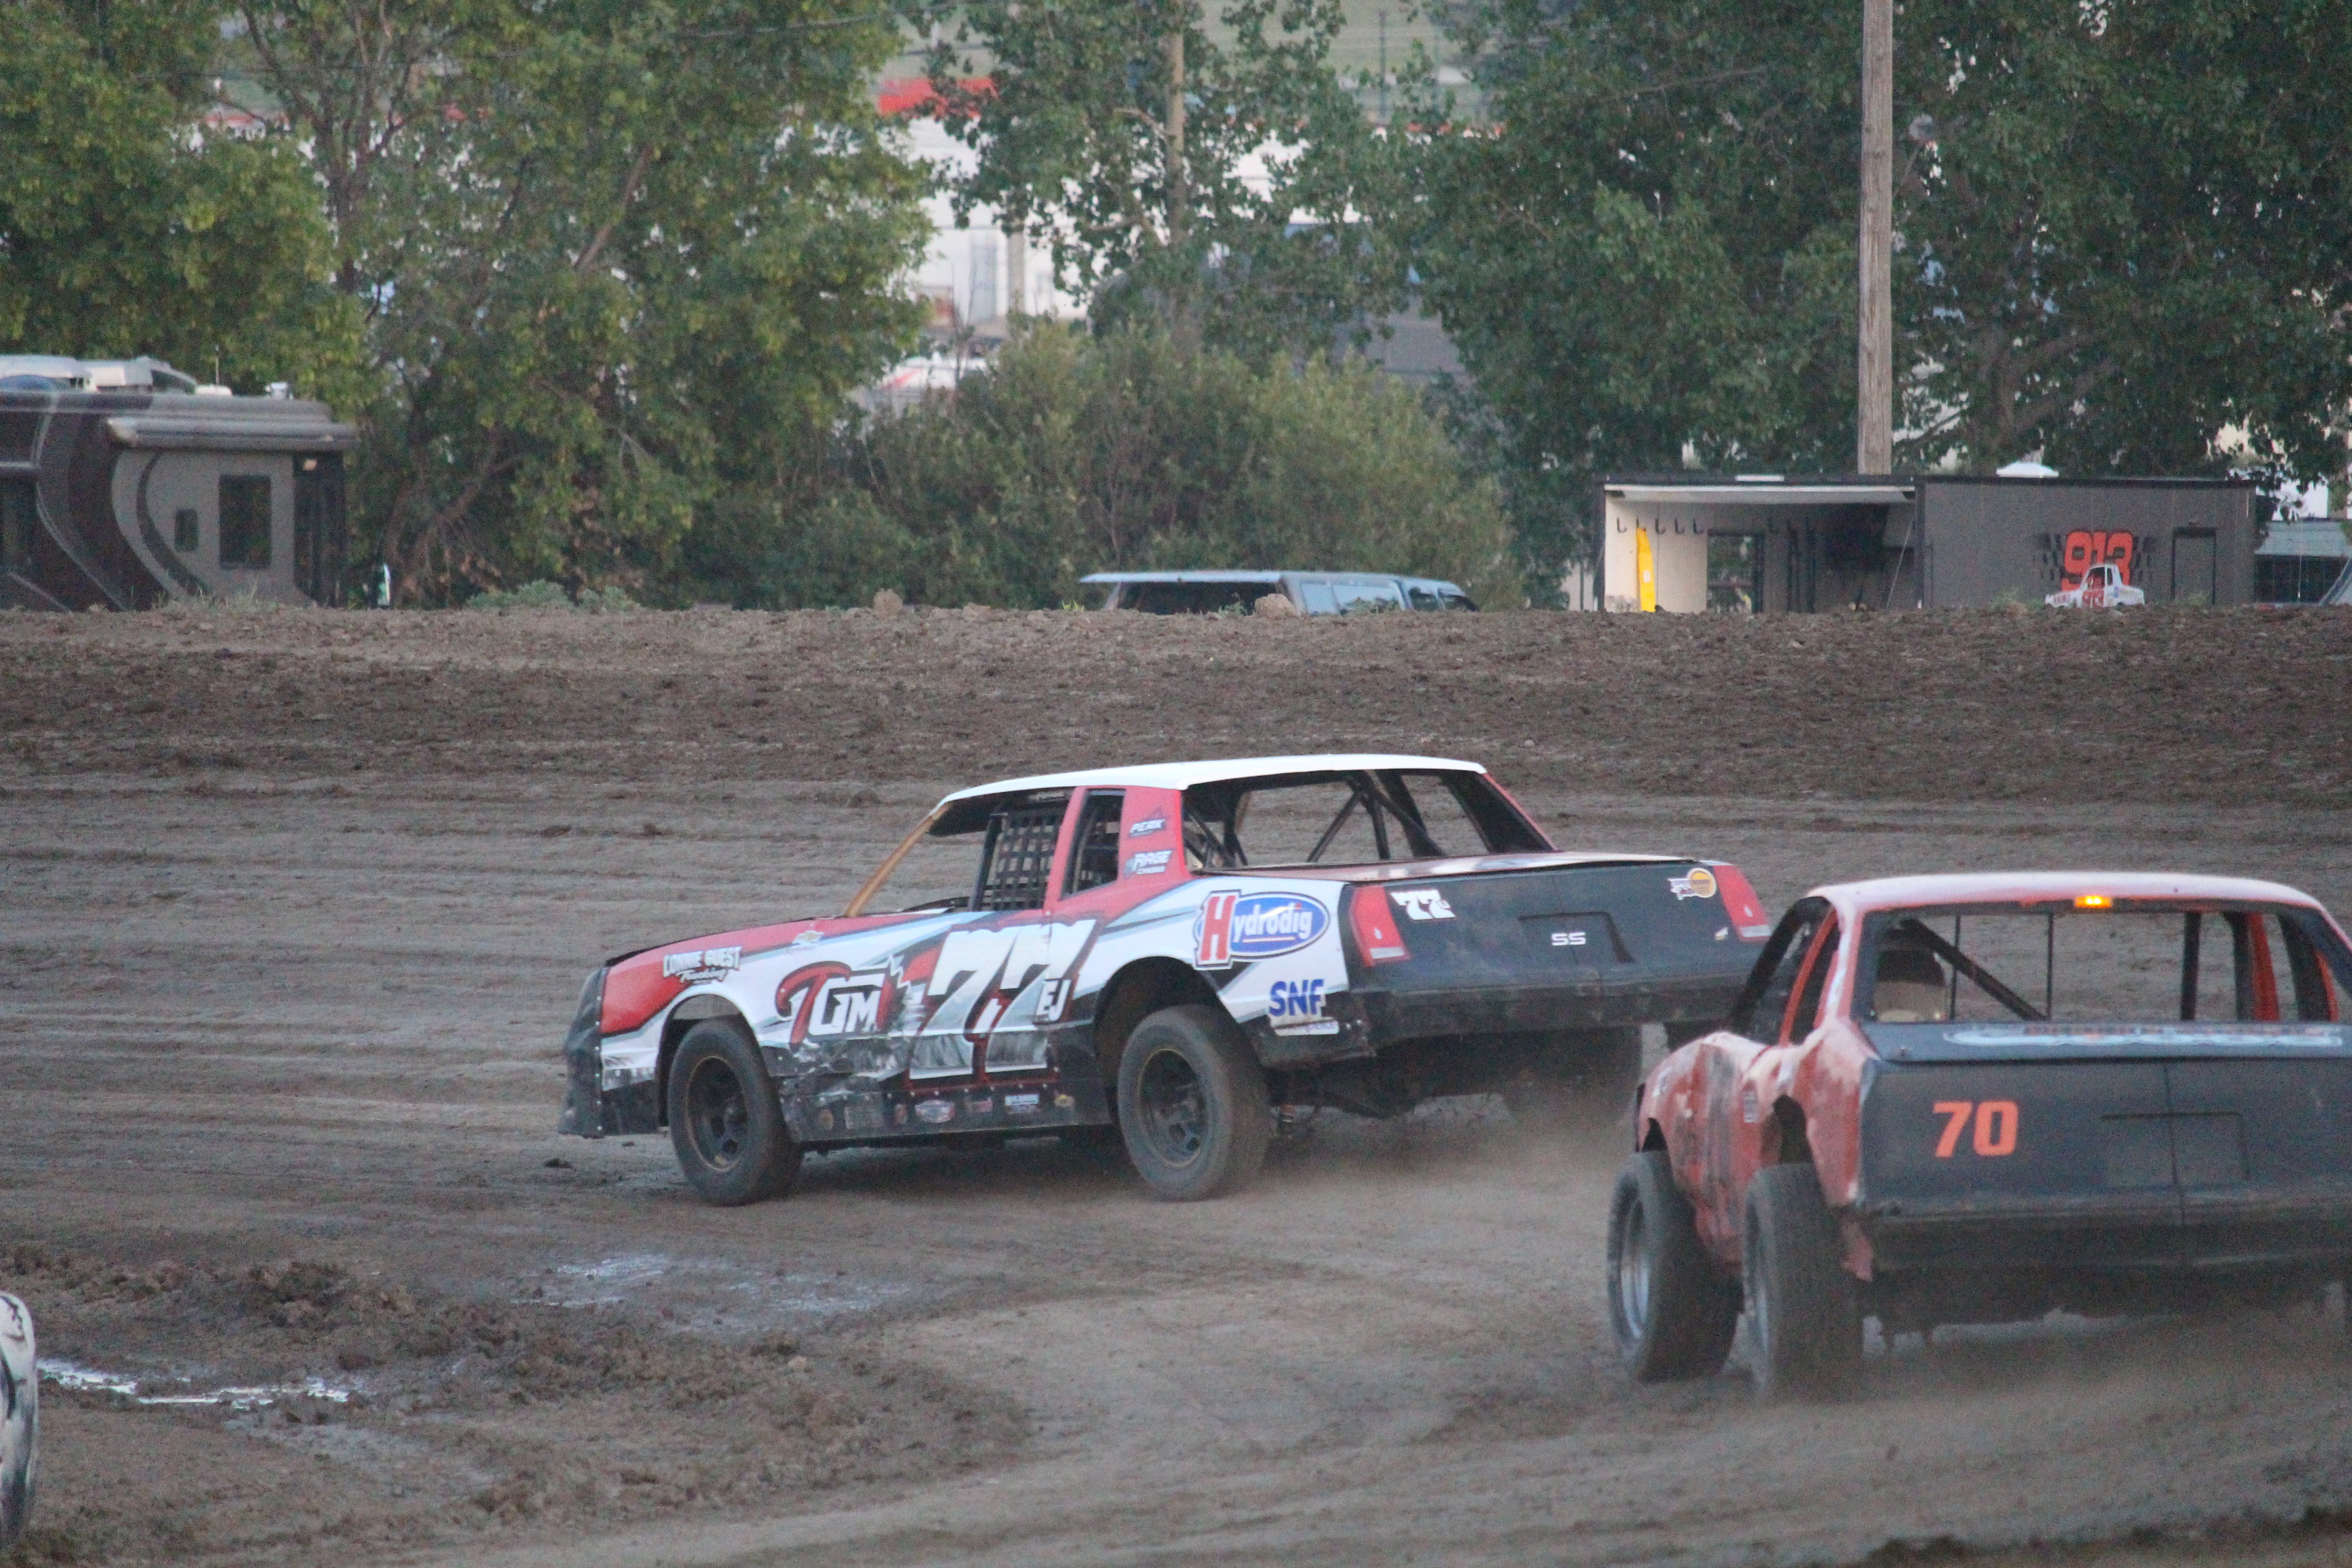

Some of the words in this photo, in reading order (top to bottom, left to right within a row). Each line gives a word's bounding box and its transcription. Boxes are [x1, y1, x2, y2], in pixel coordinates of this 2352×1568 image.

[1130, 819, 1166, 834] PEAK
[1131, 849, 1173, 872] RAGE
[1390, 889, 1456, 920] 77
[1200, 894, 1313, 962] Hydrodig
[1551, 932, 1586, 947] SS
[909, 919, 1097, 1081] 77
[1036, 978, 1073, 1022] EJ
[1269, 979, 1324, 1017] SNF
[1933, 1101, 2019, 1159] 70
